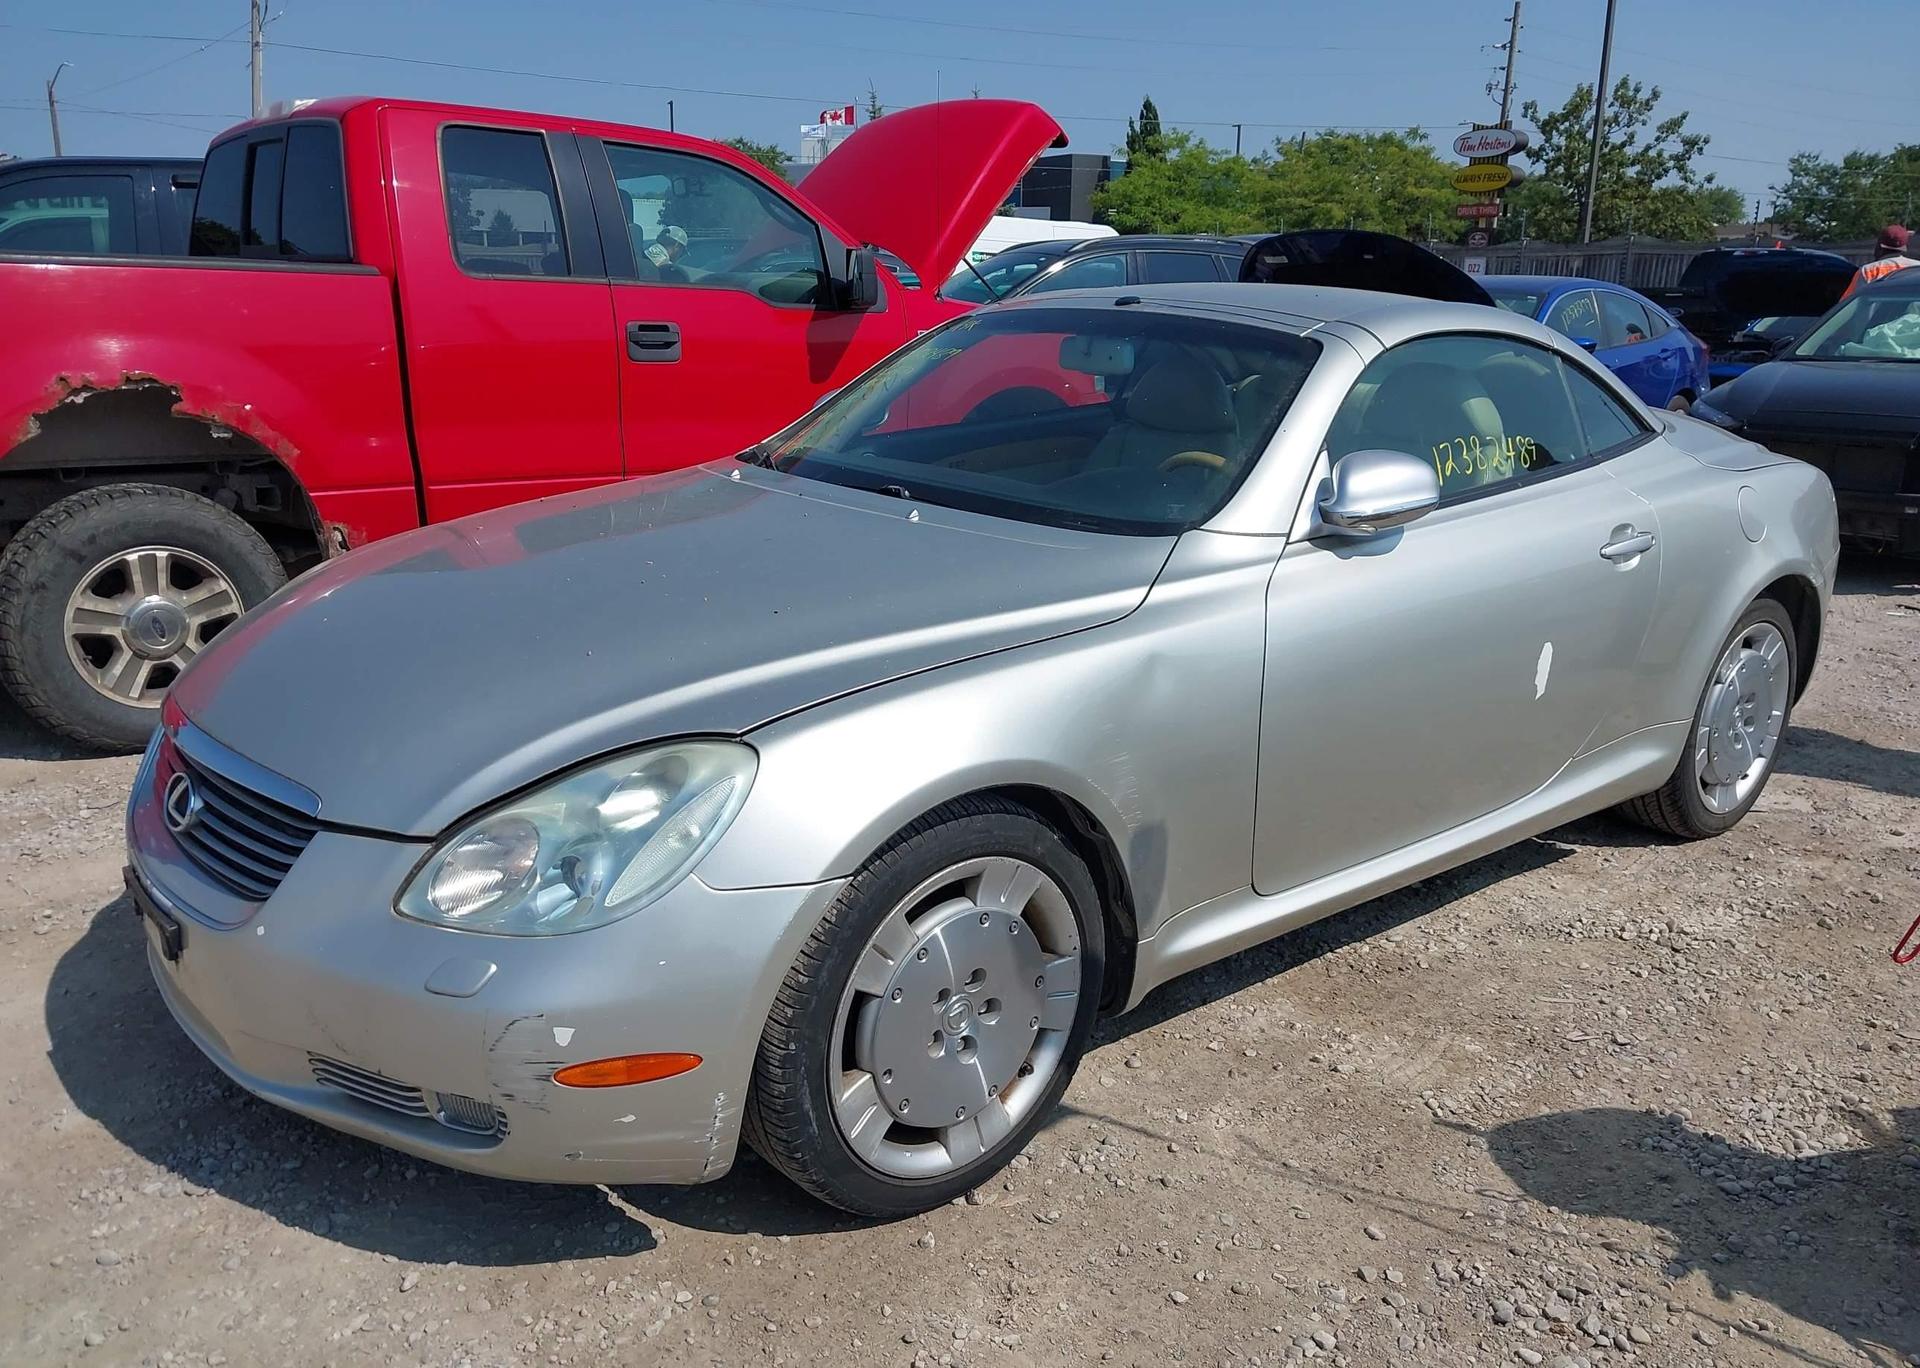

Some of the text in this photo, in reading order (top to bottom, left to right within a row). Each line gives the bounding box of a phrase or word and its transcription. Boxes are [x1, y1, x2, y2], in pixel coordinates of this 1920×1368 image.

[1459, 135, 1512, 152] Tim Hortons
[1454, 171, 1508, 184] ALWAYS FRESH
[1457, 205, 1498, 217] DRIVE THRU
[1432, 435, 1536, 487] 12382489
